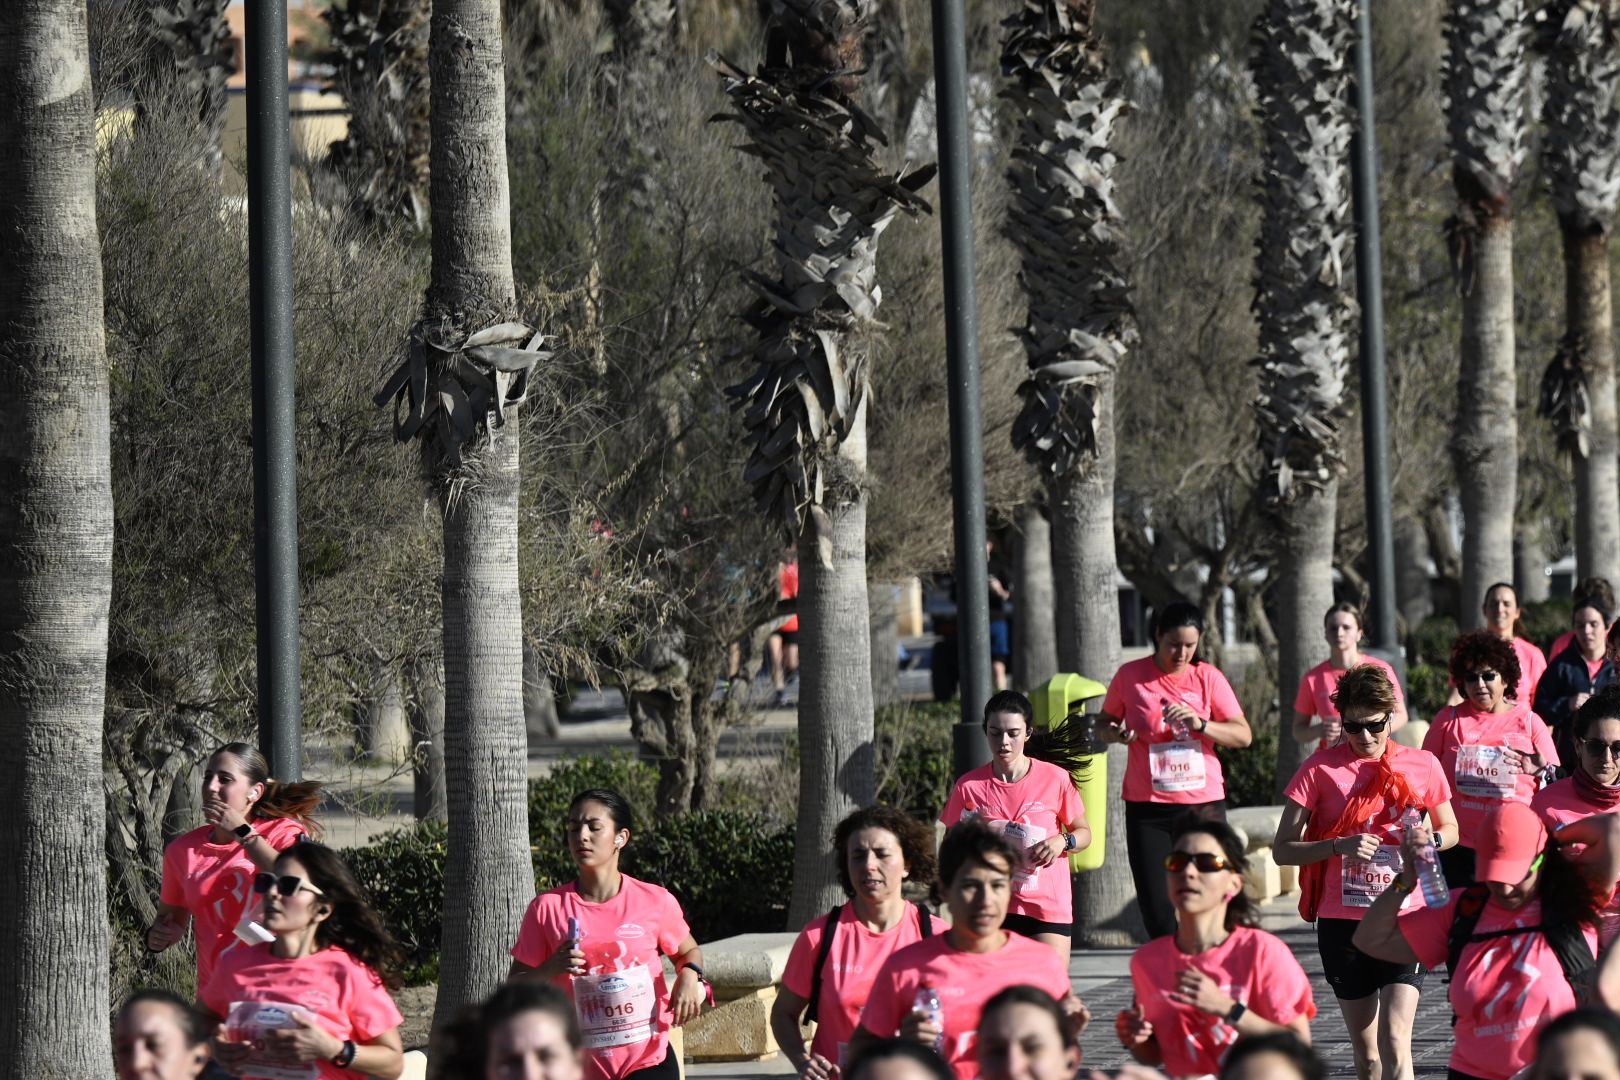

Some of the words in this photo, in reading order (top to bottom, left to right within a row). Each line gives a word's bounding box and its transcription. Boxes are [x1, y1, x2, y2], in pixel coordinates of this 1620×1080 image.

[1170, 763, 1190, 773] 016
[1476, 767, 1498, 777] 016
[1365, 872, 1392, 884] 016
[604, 1002, 634, 1018] 016
